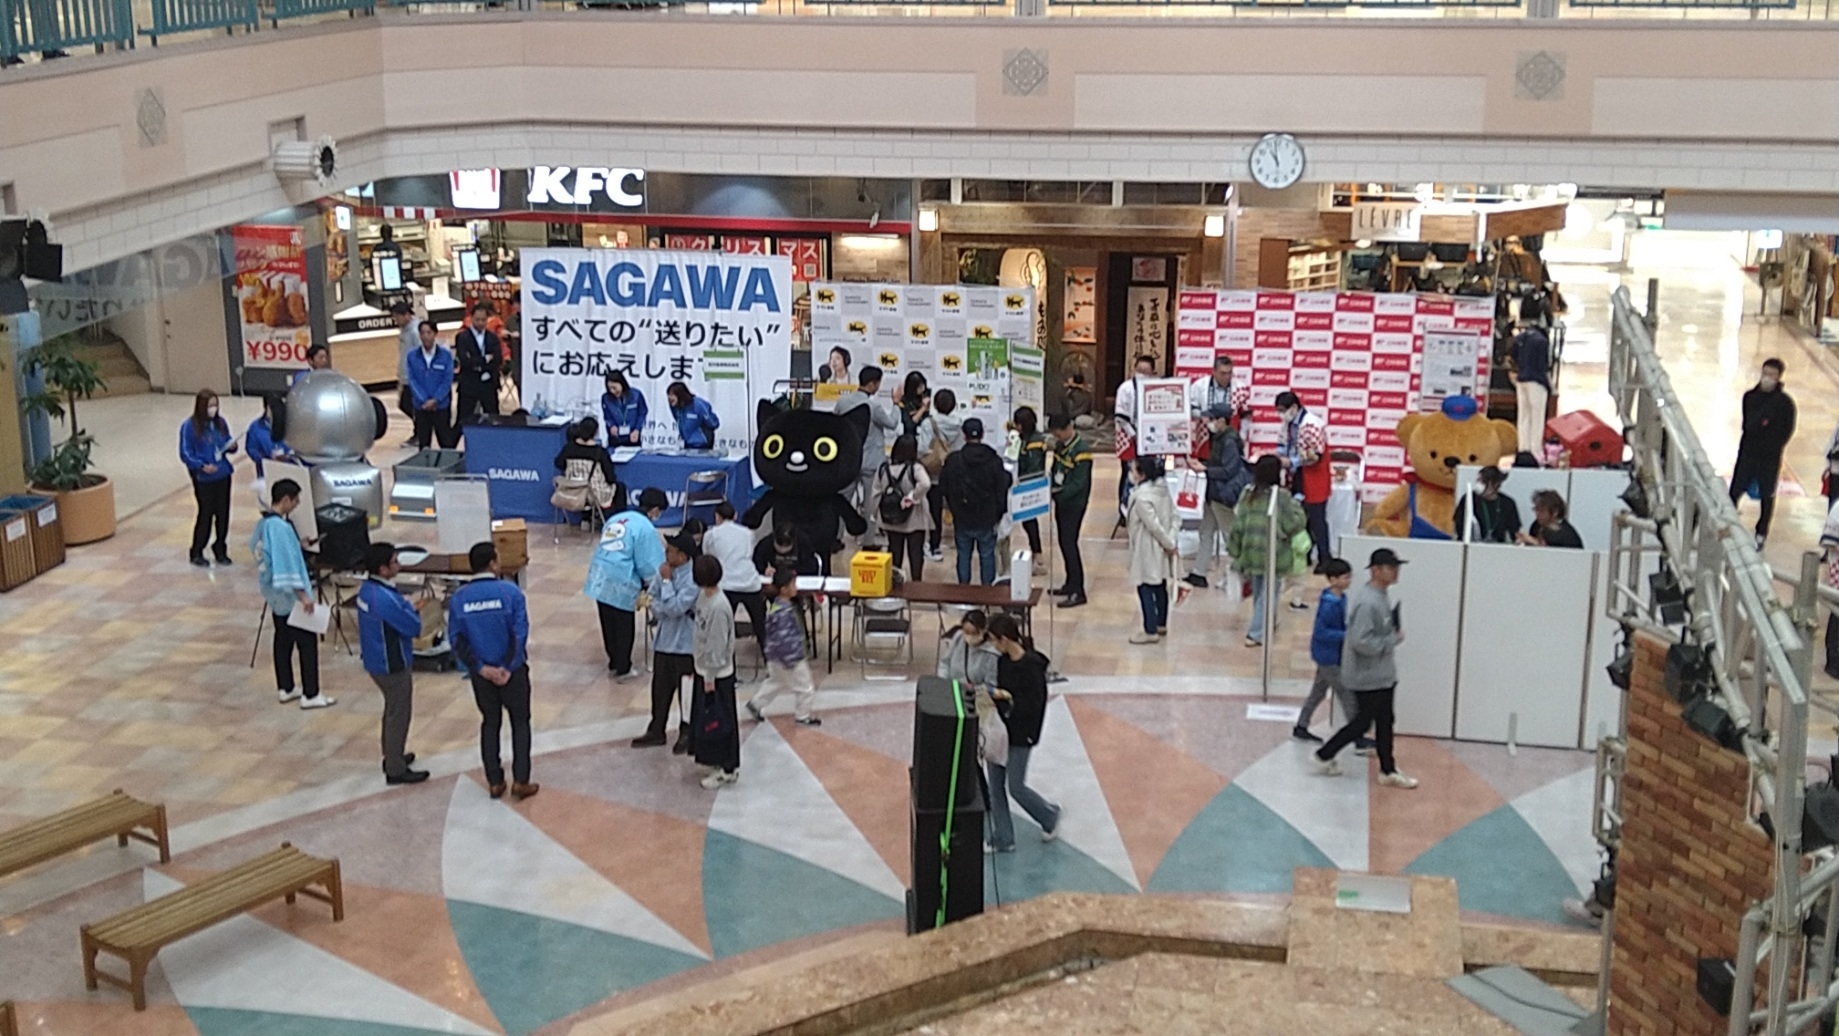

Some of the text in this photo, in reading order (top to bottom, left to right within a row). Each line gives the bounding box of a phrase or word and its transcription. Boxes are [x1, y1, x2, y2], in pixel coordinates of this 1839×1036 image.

[527, 165, 645, 206] KFC
[531, 259, 781, 313] SAGAWA
[246, 340, 309, 362] ¥990
[533, 350, 705, 381] にお応えしま
[489, 468, 540, 481] SAGAWA
